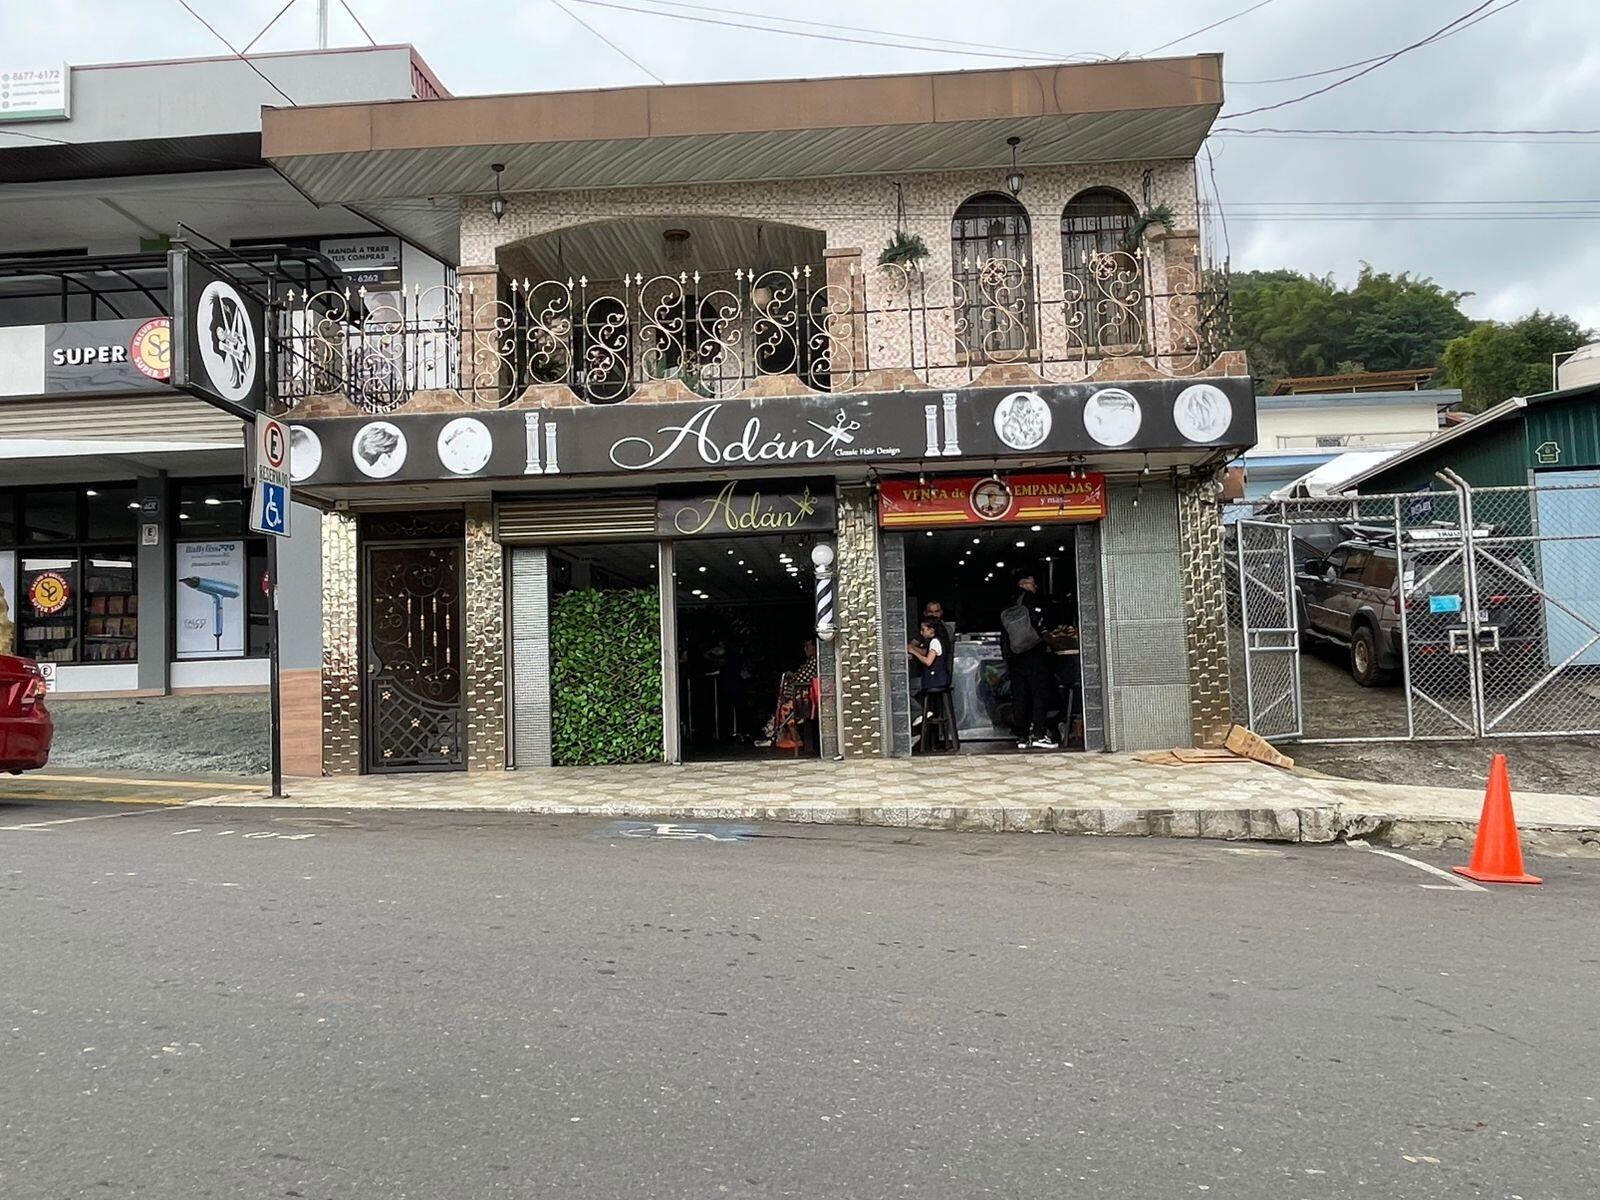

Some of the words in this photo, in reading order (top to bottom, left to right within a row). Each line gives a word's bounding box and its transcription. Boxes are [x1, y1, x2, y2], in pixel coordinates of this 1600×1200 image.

[13, 71, 60, 81] 8677-6172
[328, 244, 356, 254] MANDÁ
[134, 324, 152, 346] SALUD
[53, 345, 126, 365] SUPER
[134, 356, 159, 377] SUPER
[271, 429, 278, 460] E
[609, 403, 832, 470] Adán
[834, 448, 858, 457] Classic
[860, 447, 875, 455] Hair
[876, 446, 901, 456] Design
[903, 489, 948, 500] VENTA
[951, 488, 966, 498] de
[1014, 482, 1092, 496] EMPANADAS
[674, 480, 803, 534] Adán
[43, 667, 48, 675] E
